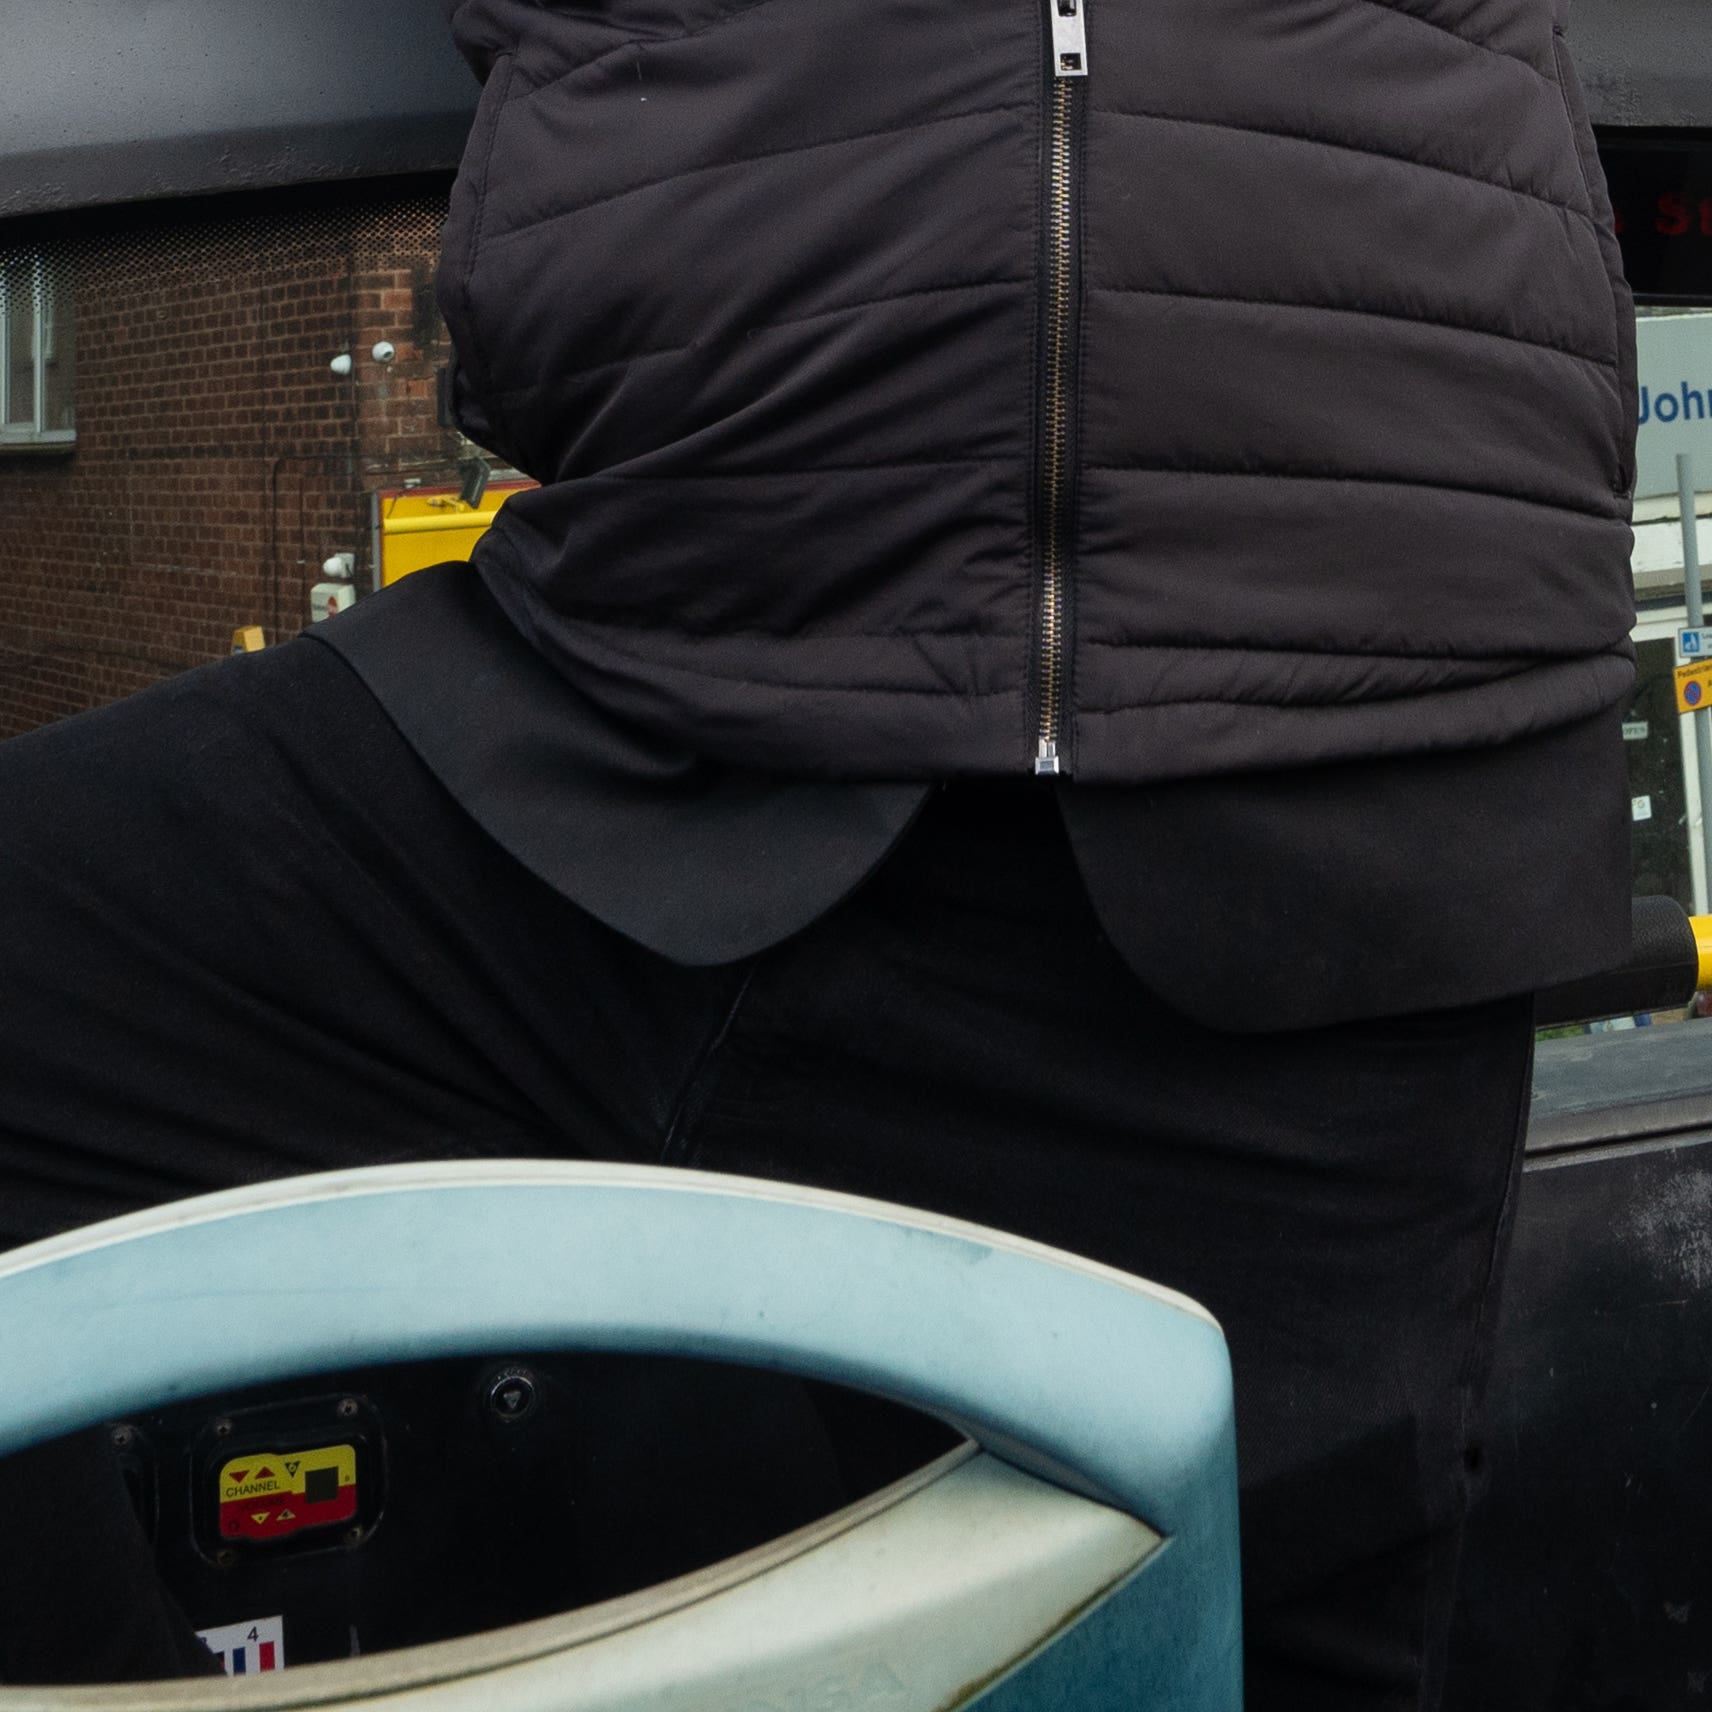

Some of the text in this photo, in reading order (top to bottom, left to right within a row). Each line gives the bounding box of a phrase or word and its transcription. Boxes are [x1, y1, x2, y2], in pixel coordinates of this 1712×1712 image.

[1677, 664, 1712, 679] Pedestrian
[226, 1481, 280, 1497] CHANNEL
[247, 1626, 259, 1642] 4
